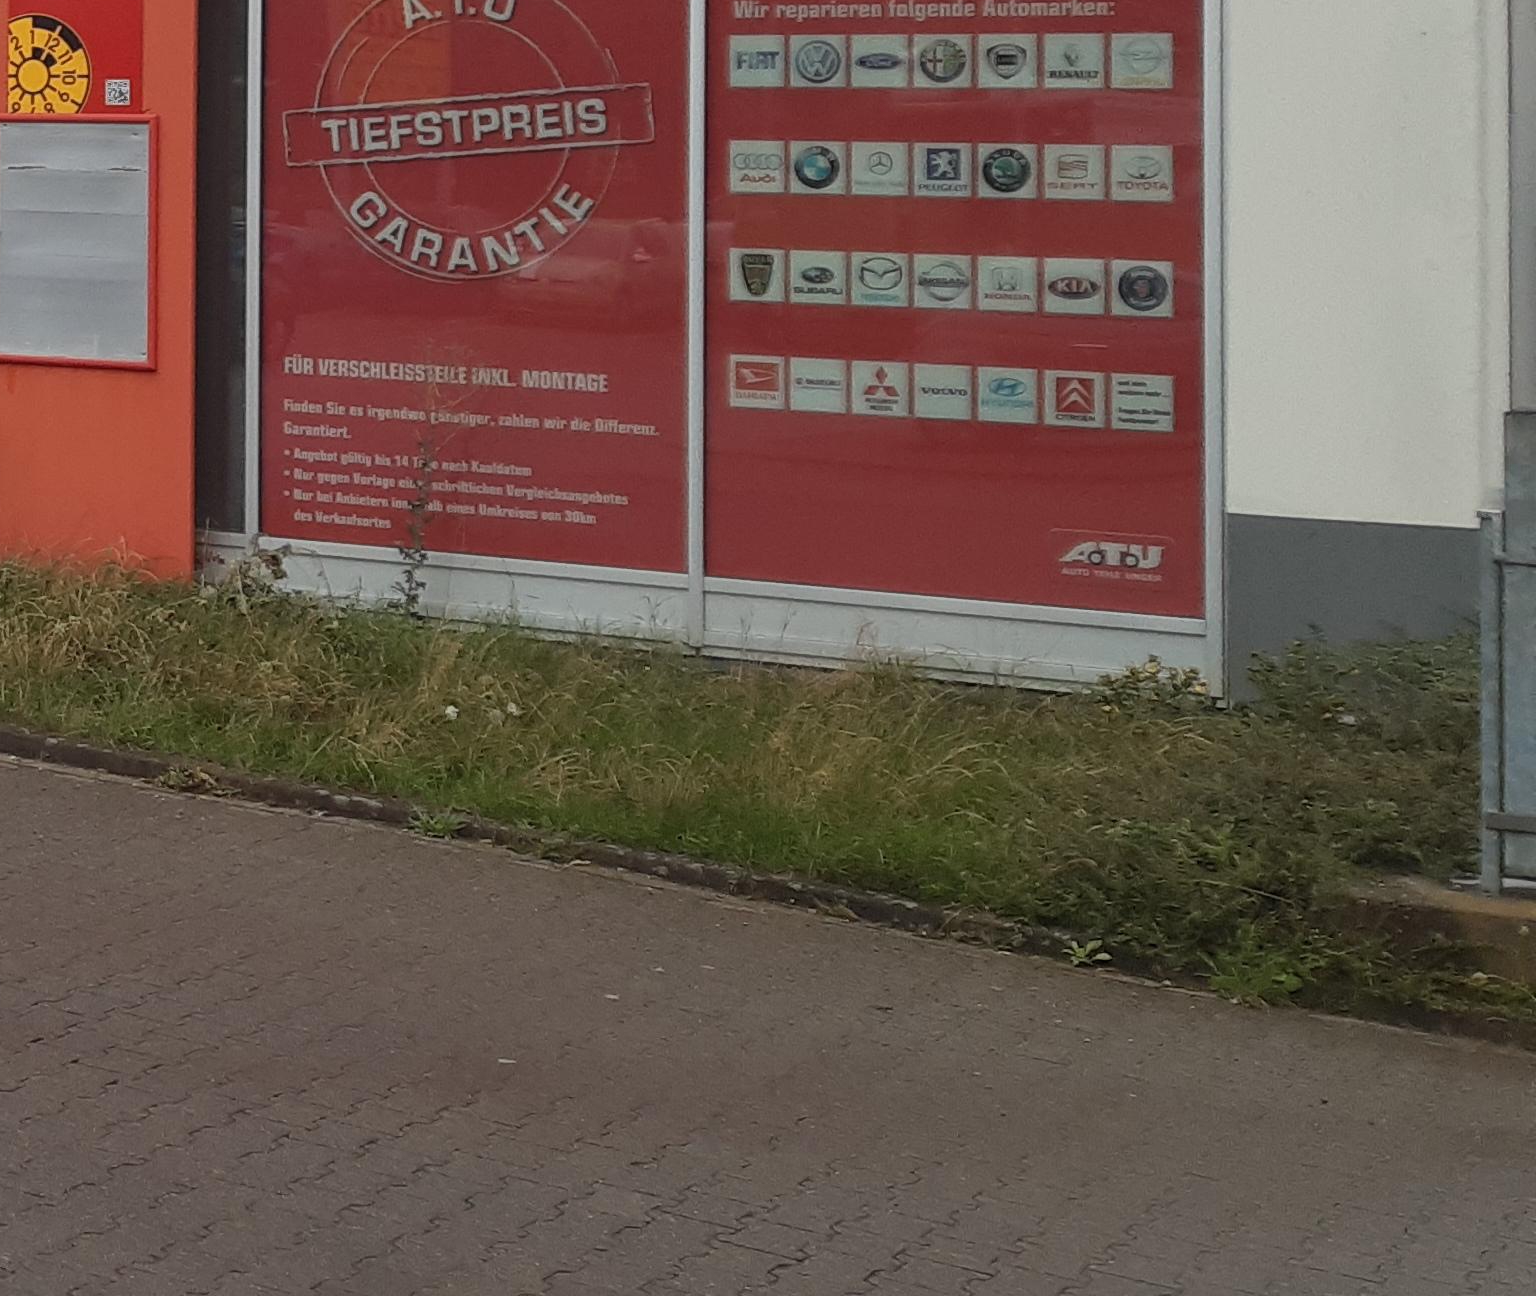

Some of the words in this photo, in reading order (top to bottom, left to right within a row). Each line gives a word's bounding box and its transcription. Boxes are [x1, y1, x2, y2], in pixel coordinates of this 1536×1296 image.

[734, 0, 769, 19] Wir
[776, 1, 882, 22] reparieren
[736, 50, 780, 70] FIAT
[322, 98, 608, 153] TIEFSTPREIS
[349, 183, 595, 274] GARANTIE
[1055, 280, 1094, 293] KIA
[284, 355, 314, 375] FÜR
[522, 369, 609, 393] MONTAGE
[283, 399, 323, 413] Finden
[327, 401, 346, 416] Sie
